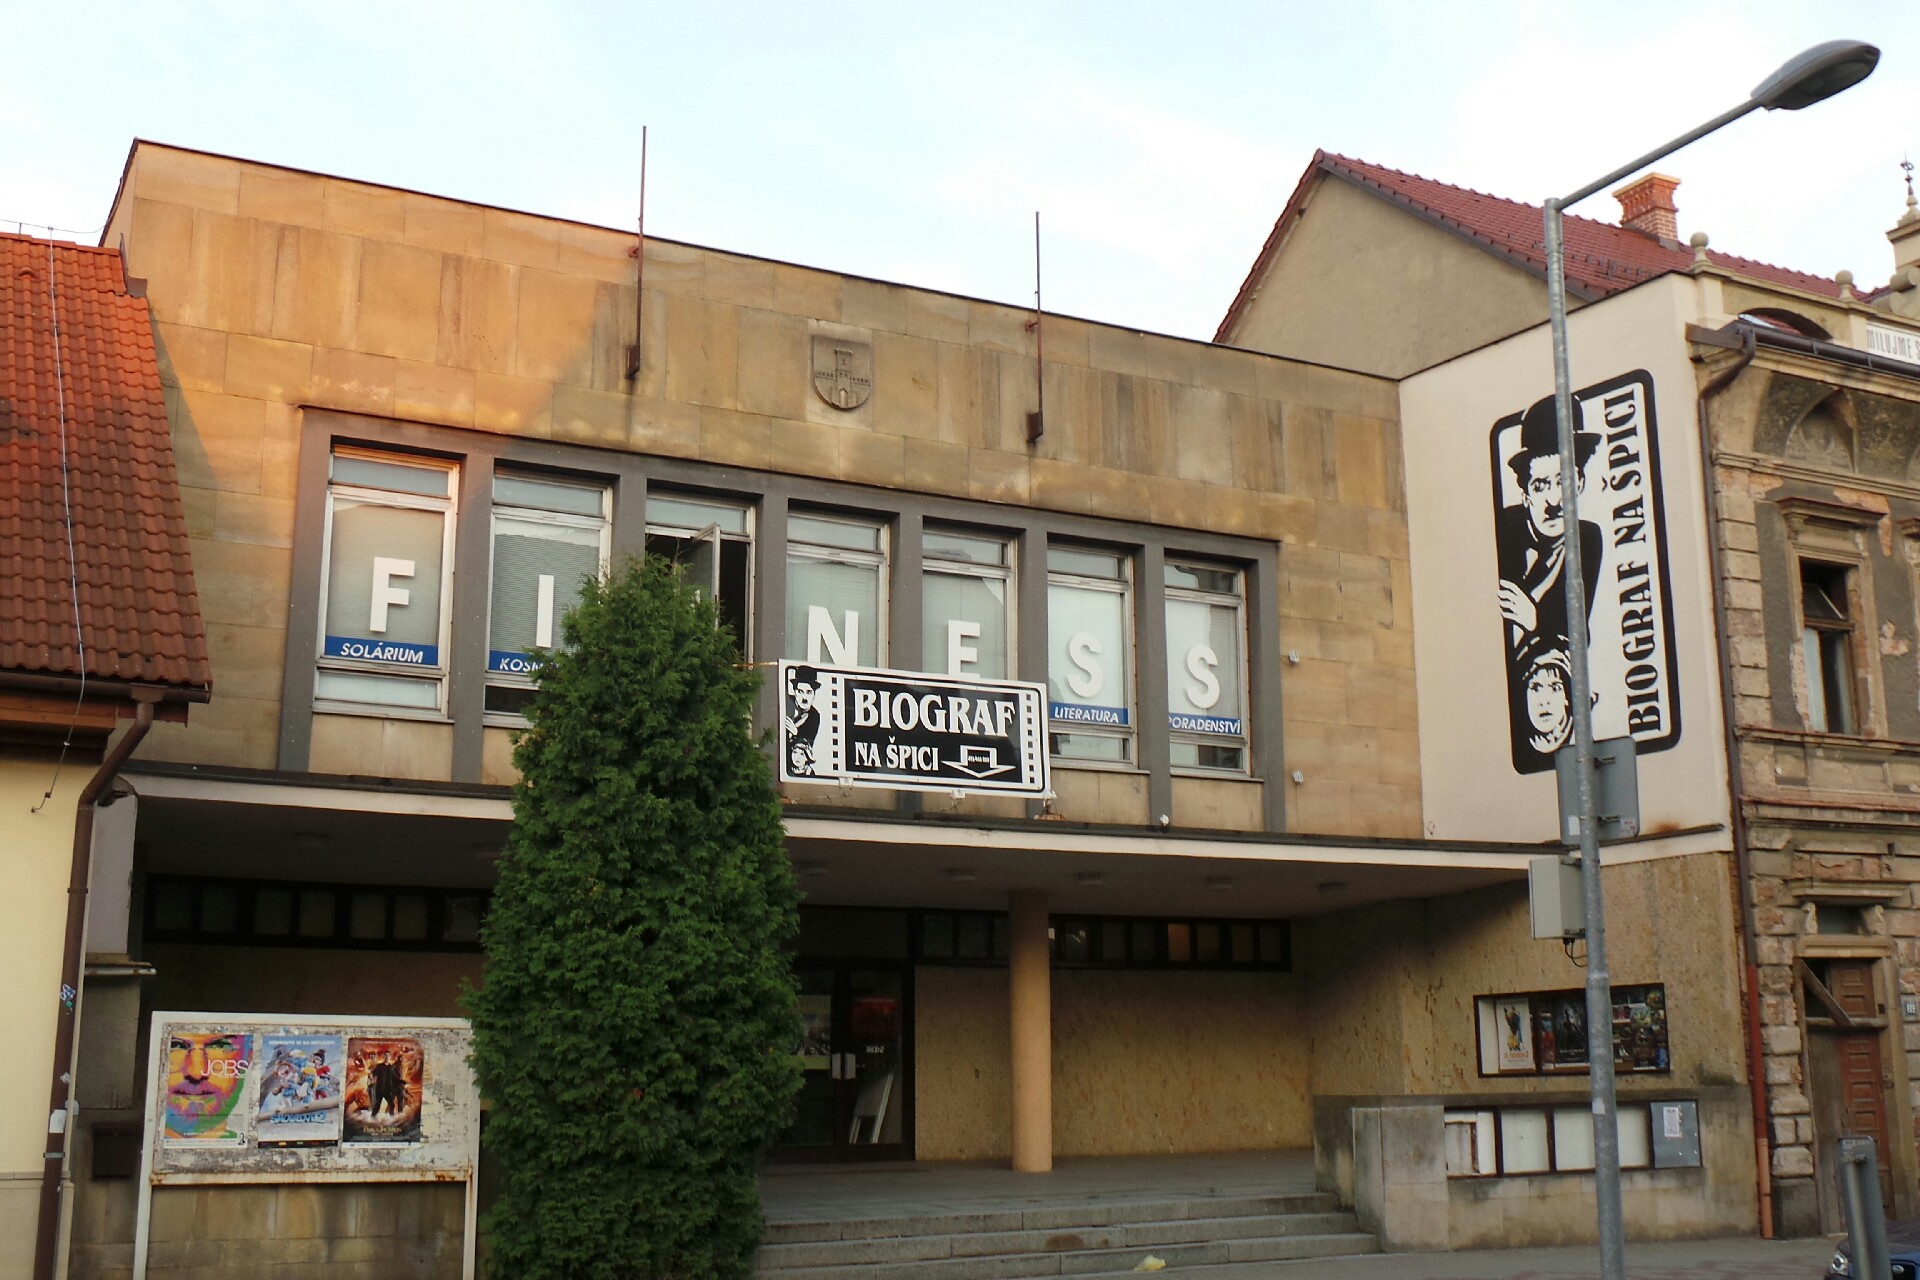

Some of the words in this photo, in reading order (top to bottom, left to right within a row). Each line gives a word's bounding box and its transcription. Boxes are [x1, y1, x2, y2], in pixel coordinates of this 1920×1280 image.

[1601, 388, 1642, 492] ŠPICI
[1613, 497, 1647, 549] NA
[340, 641, 424, 664] SOLÁRIUM
[1616, 562, 1661, 735] BIOGRAF
[853, 688, 1016, 737] BIOGRAF
[1054, 706, 1120, 724] LITERATURA
[854, 742, 882, 768] NA
[886, 735, 939, 771] ŠPICI
[200, 1060, 249, 1077] JOBS
